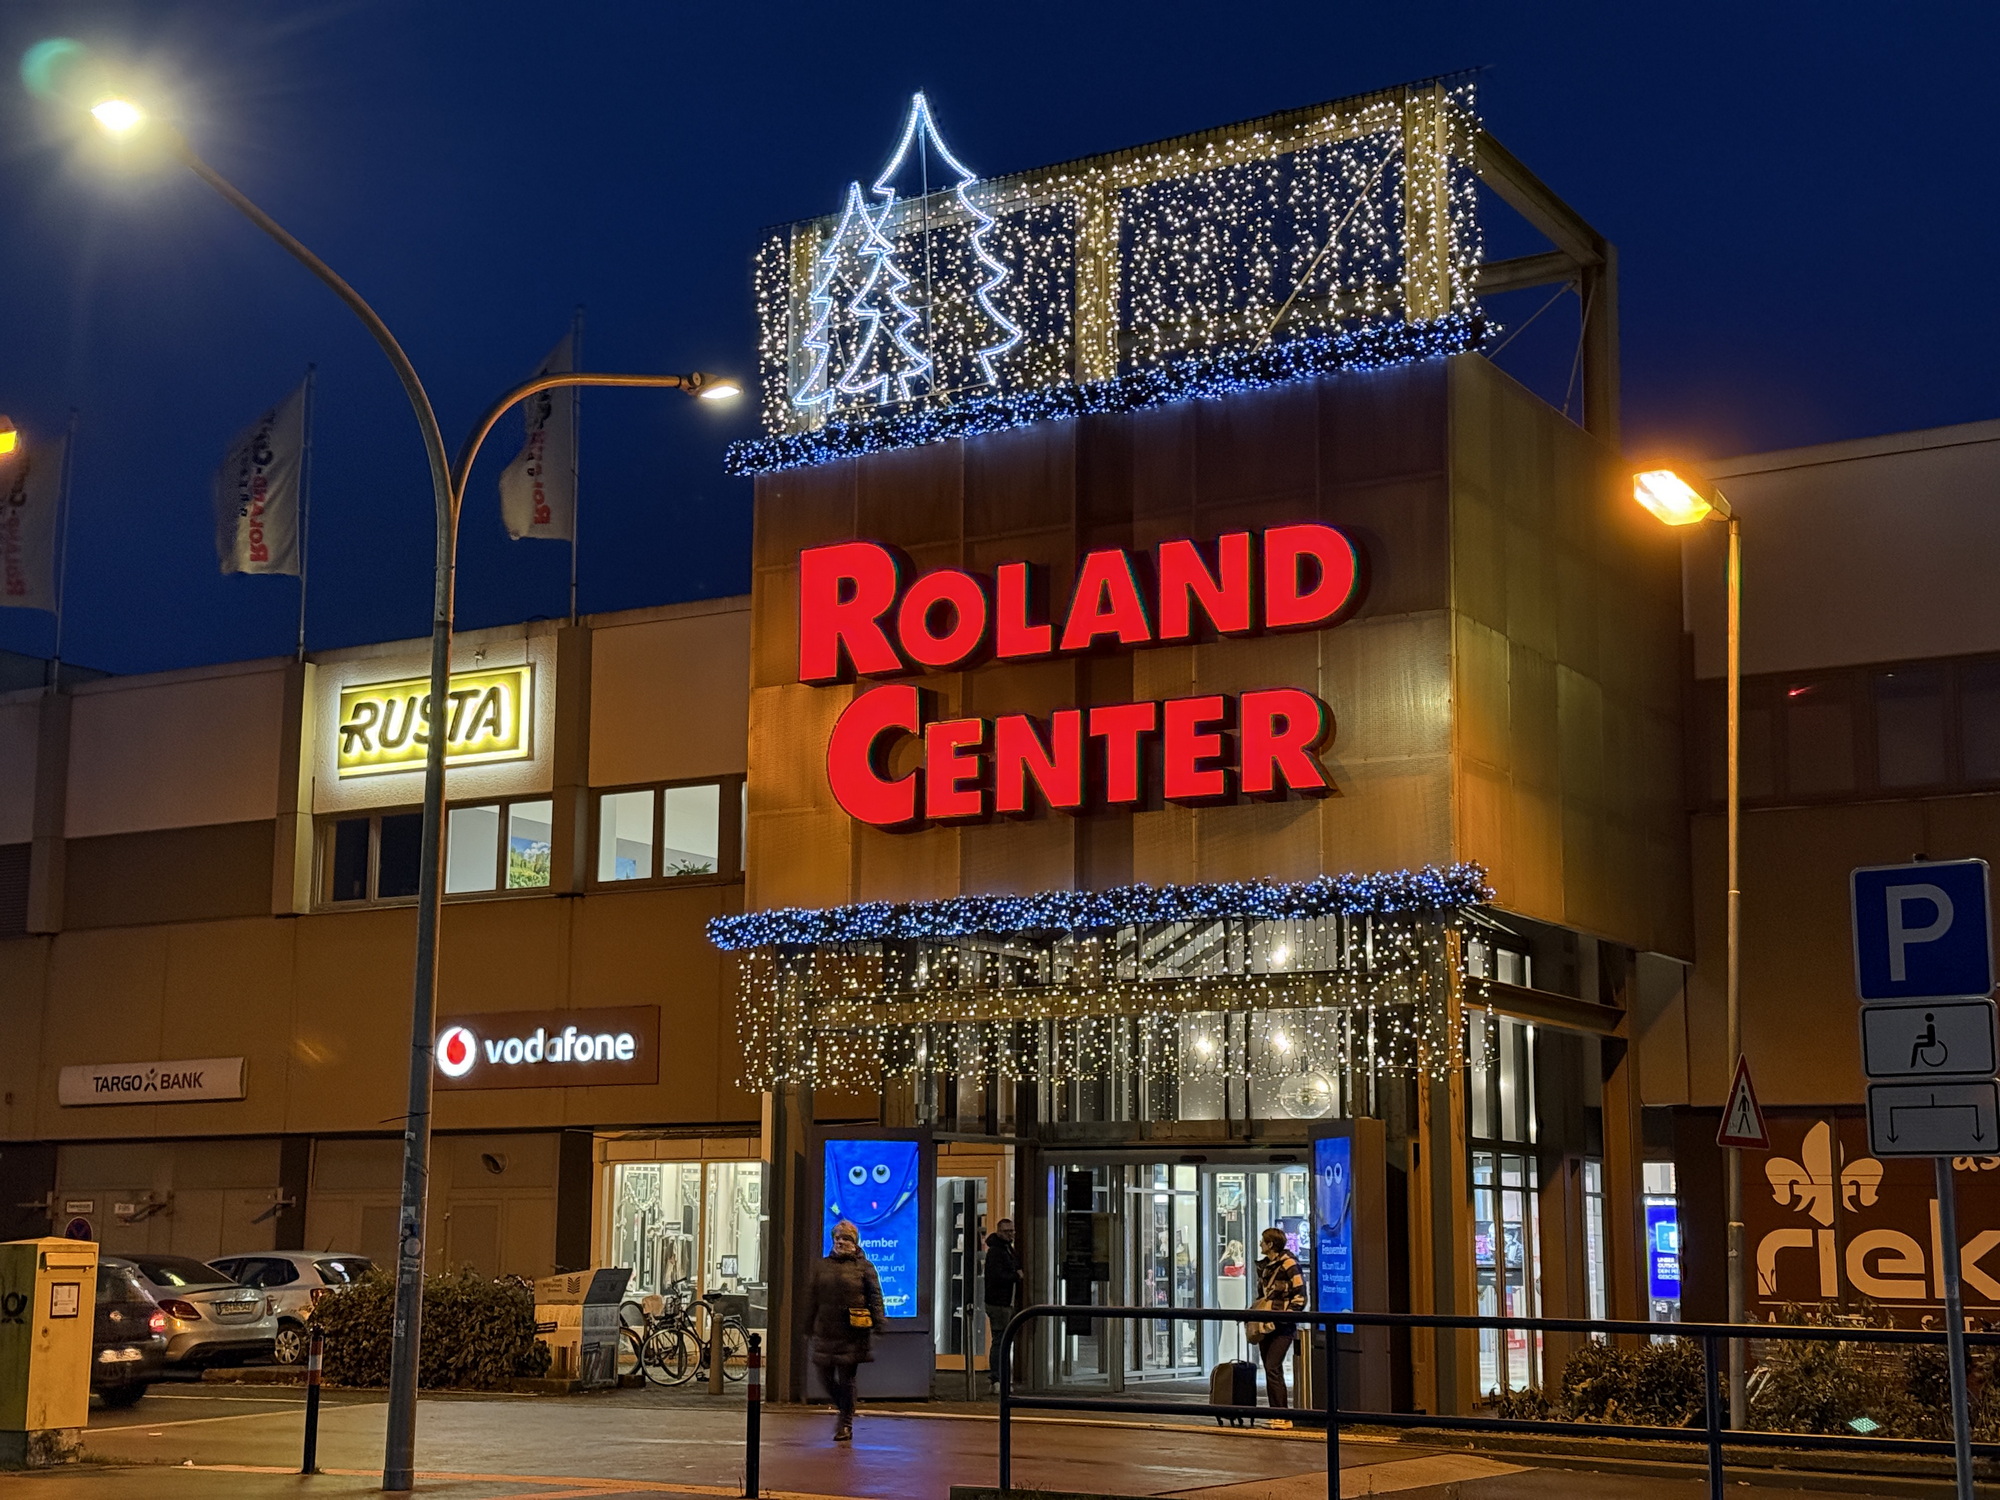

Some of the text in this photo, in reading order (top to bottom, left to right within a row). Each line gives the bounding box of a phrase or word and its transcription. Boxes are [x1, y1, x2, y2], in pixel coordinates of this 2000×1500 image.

[800, 523, 1357, 682] ROLAND
[826, 684, 1328, 826] CENTER
[1885, 883, 1954, 982] P
[484, 1026, 635, 1064] vodafone
[93, 1072, 204, 1093] TARGO BANK
[882, 1253, 895, 1261] auf
[891, 1264, 905, 1272] und
[1757, 1199, 2000, 1301] riek
